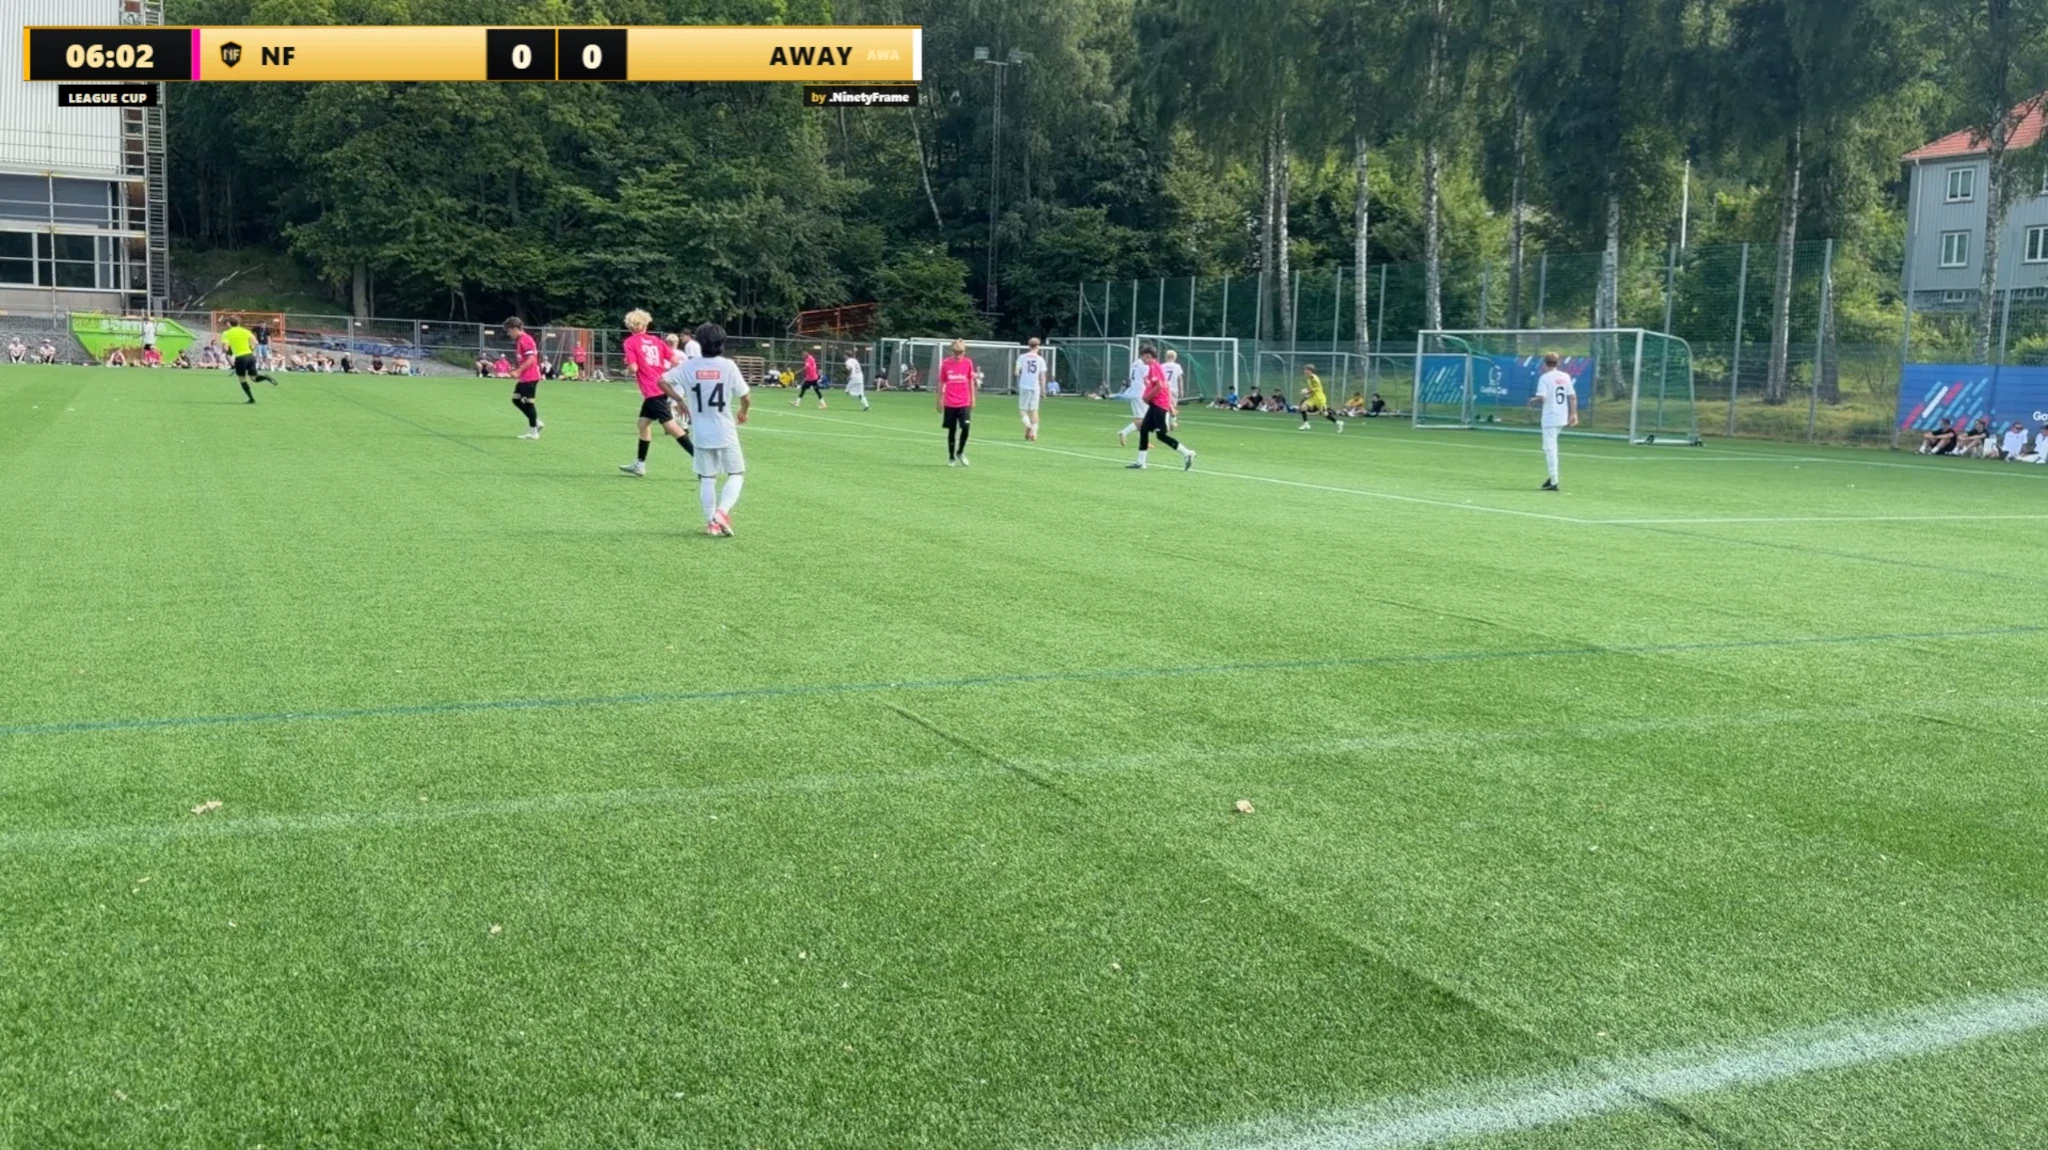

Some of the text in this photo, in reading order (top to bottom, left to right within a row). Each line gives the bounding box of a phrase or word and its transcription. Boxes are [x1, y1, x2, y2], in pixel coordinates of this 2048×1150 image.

[1027, 360, 1038, 374] 15
[1166, 370, 1174, 381] 7
[691, 382, 726, 413] 14
[1554, 386, 1566, 405] 6
